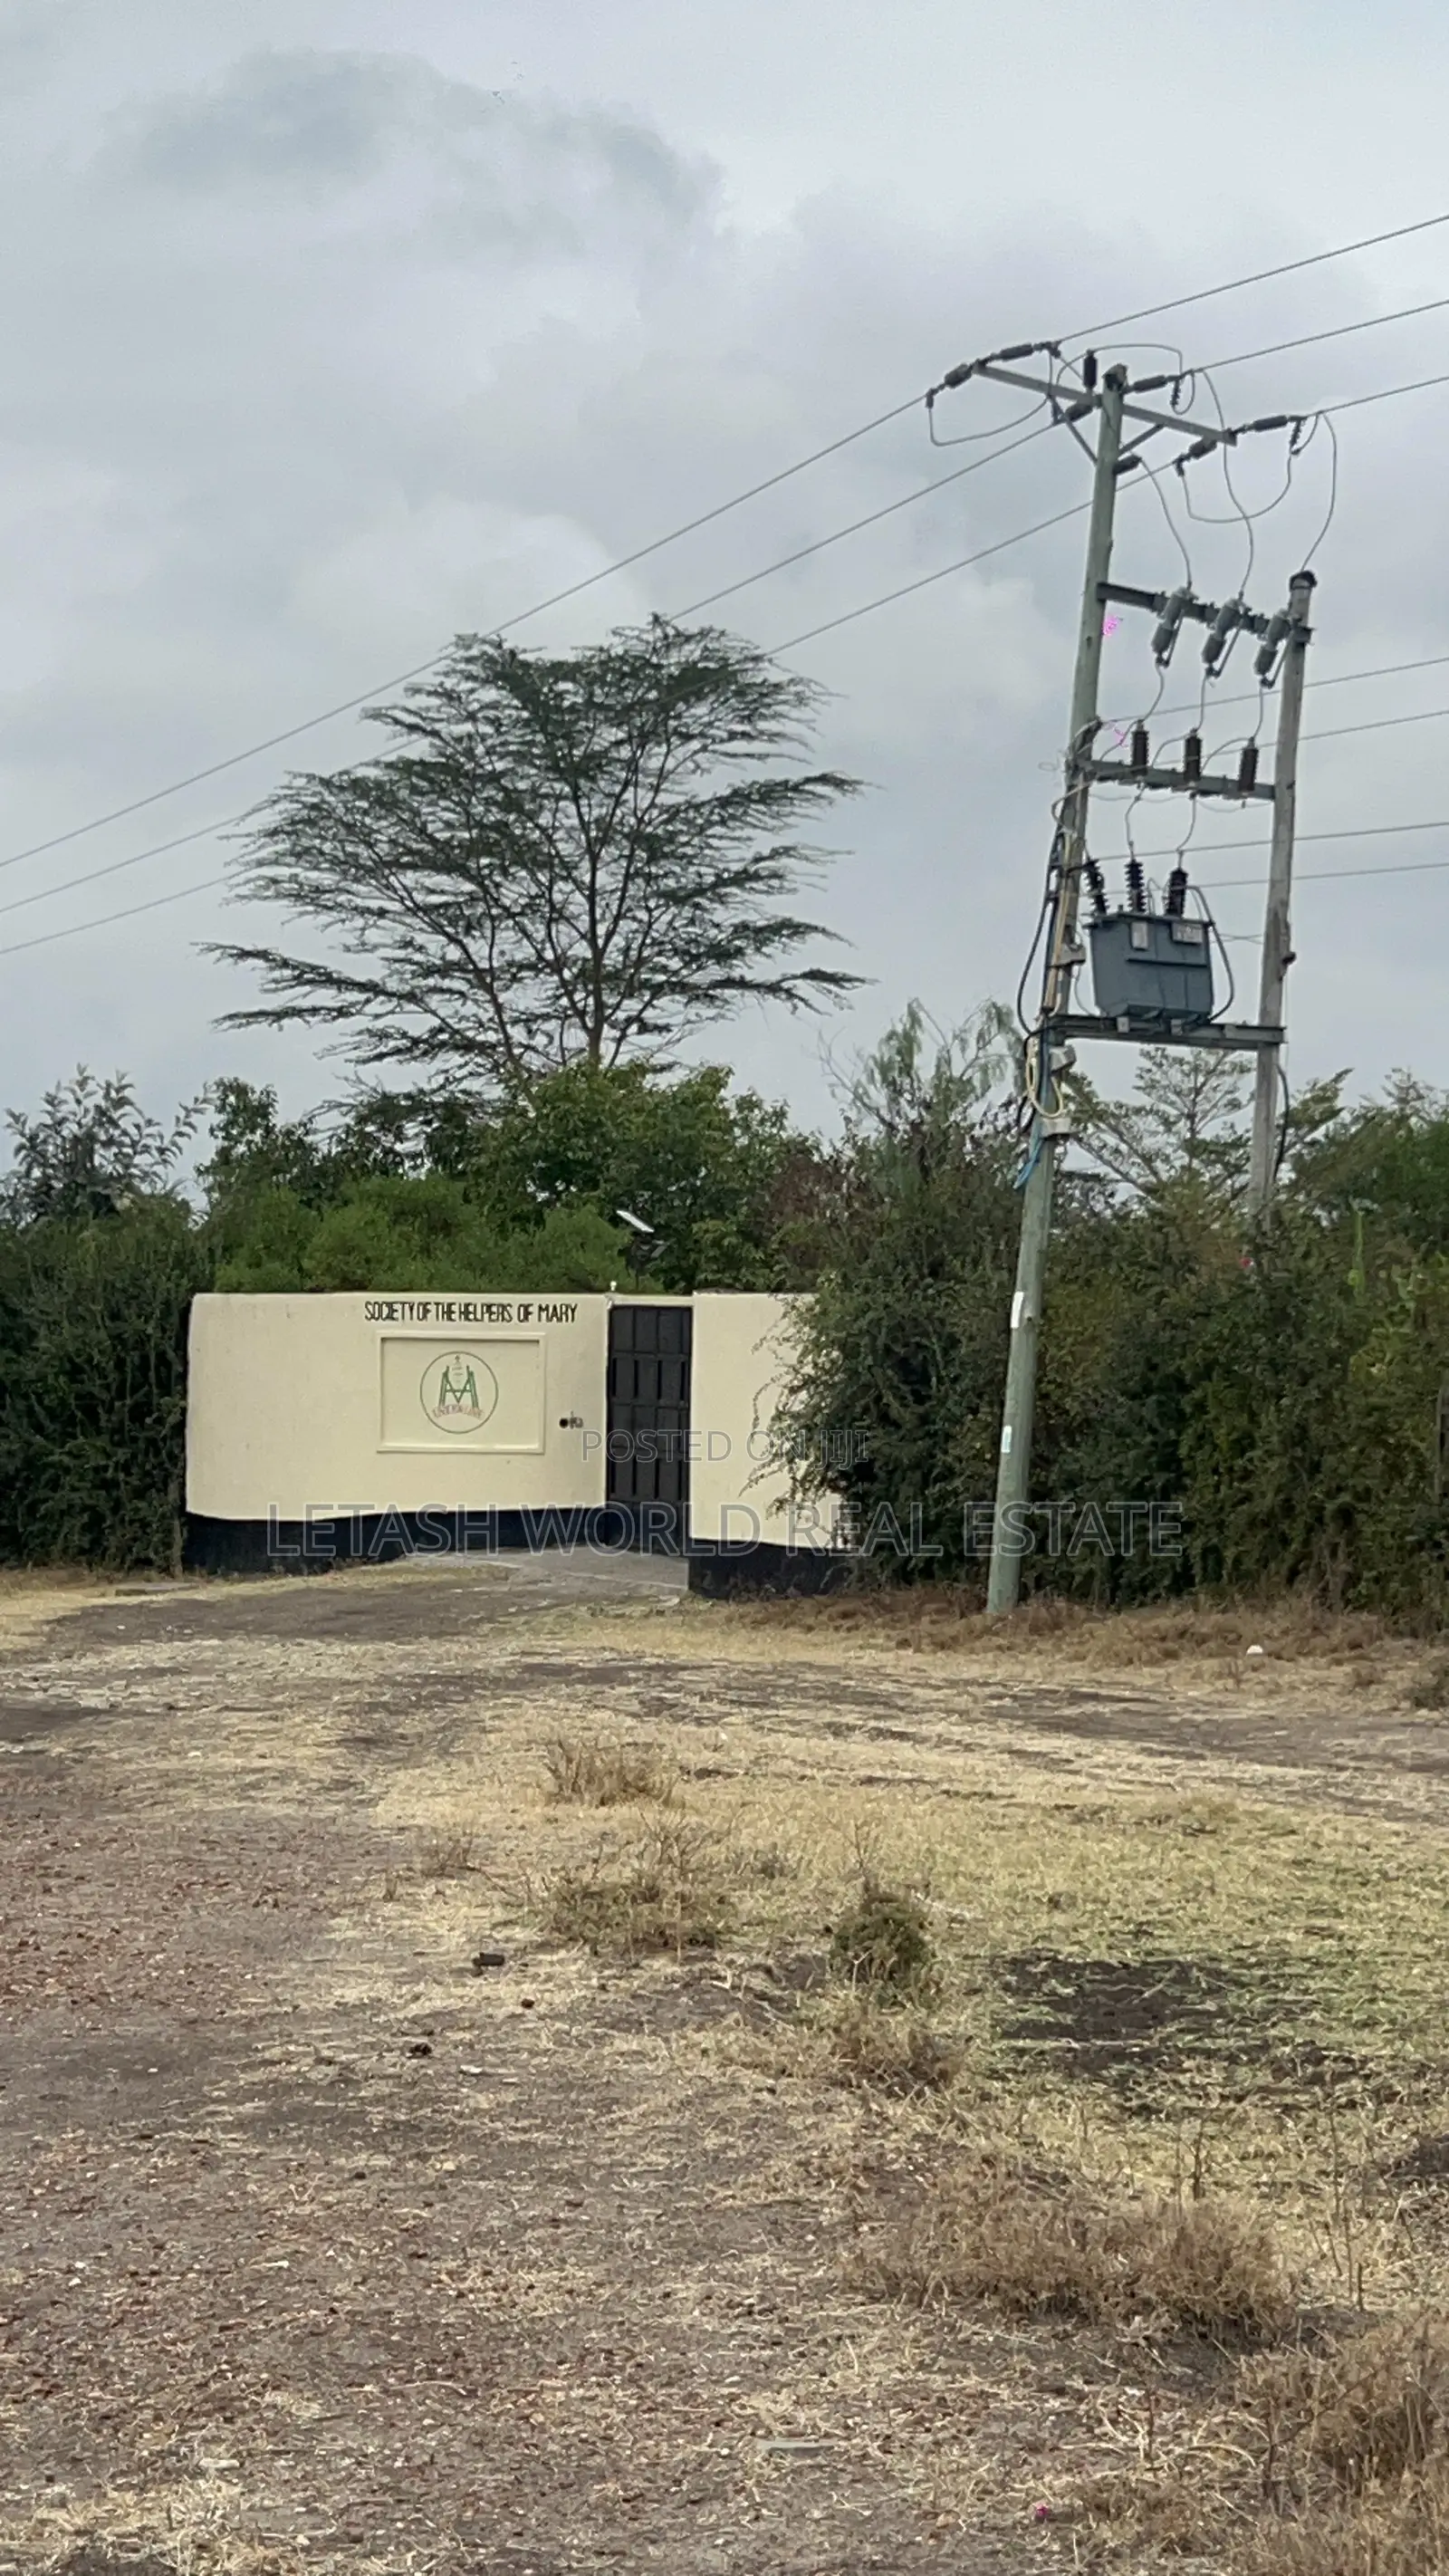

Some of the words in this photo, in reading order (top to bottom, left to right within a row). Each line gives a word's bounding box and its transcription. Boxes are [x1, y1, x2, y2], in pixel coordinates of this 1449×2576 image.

[364, 1301, 415, 1322] SOCIETY
[417, 1302, 432, 1322] OF
[434, 1302, 456, 1322] THE
[458, 1302, 513, 1322] HELPERS
[517, 1302, 533, 1323] OF
[538, 1302, 578, 1323] MARY
